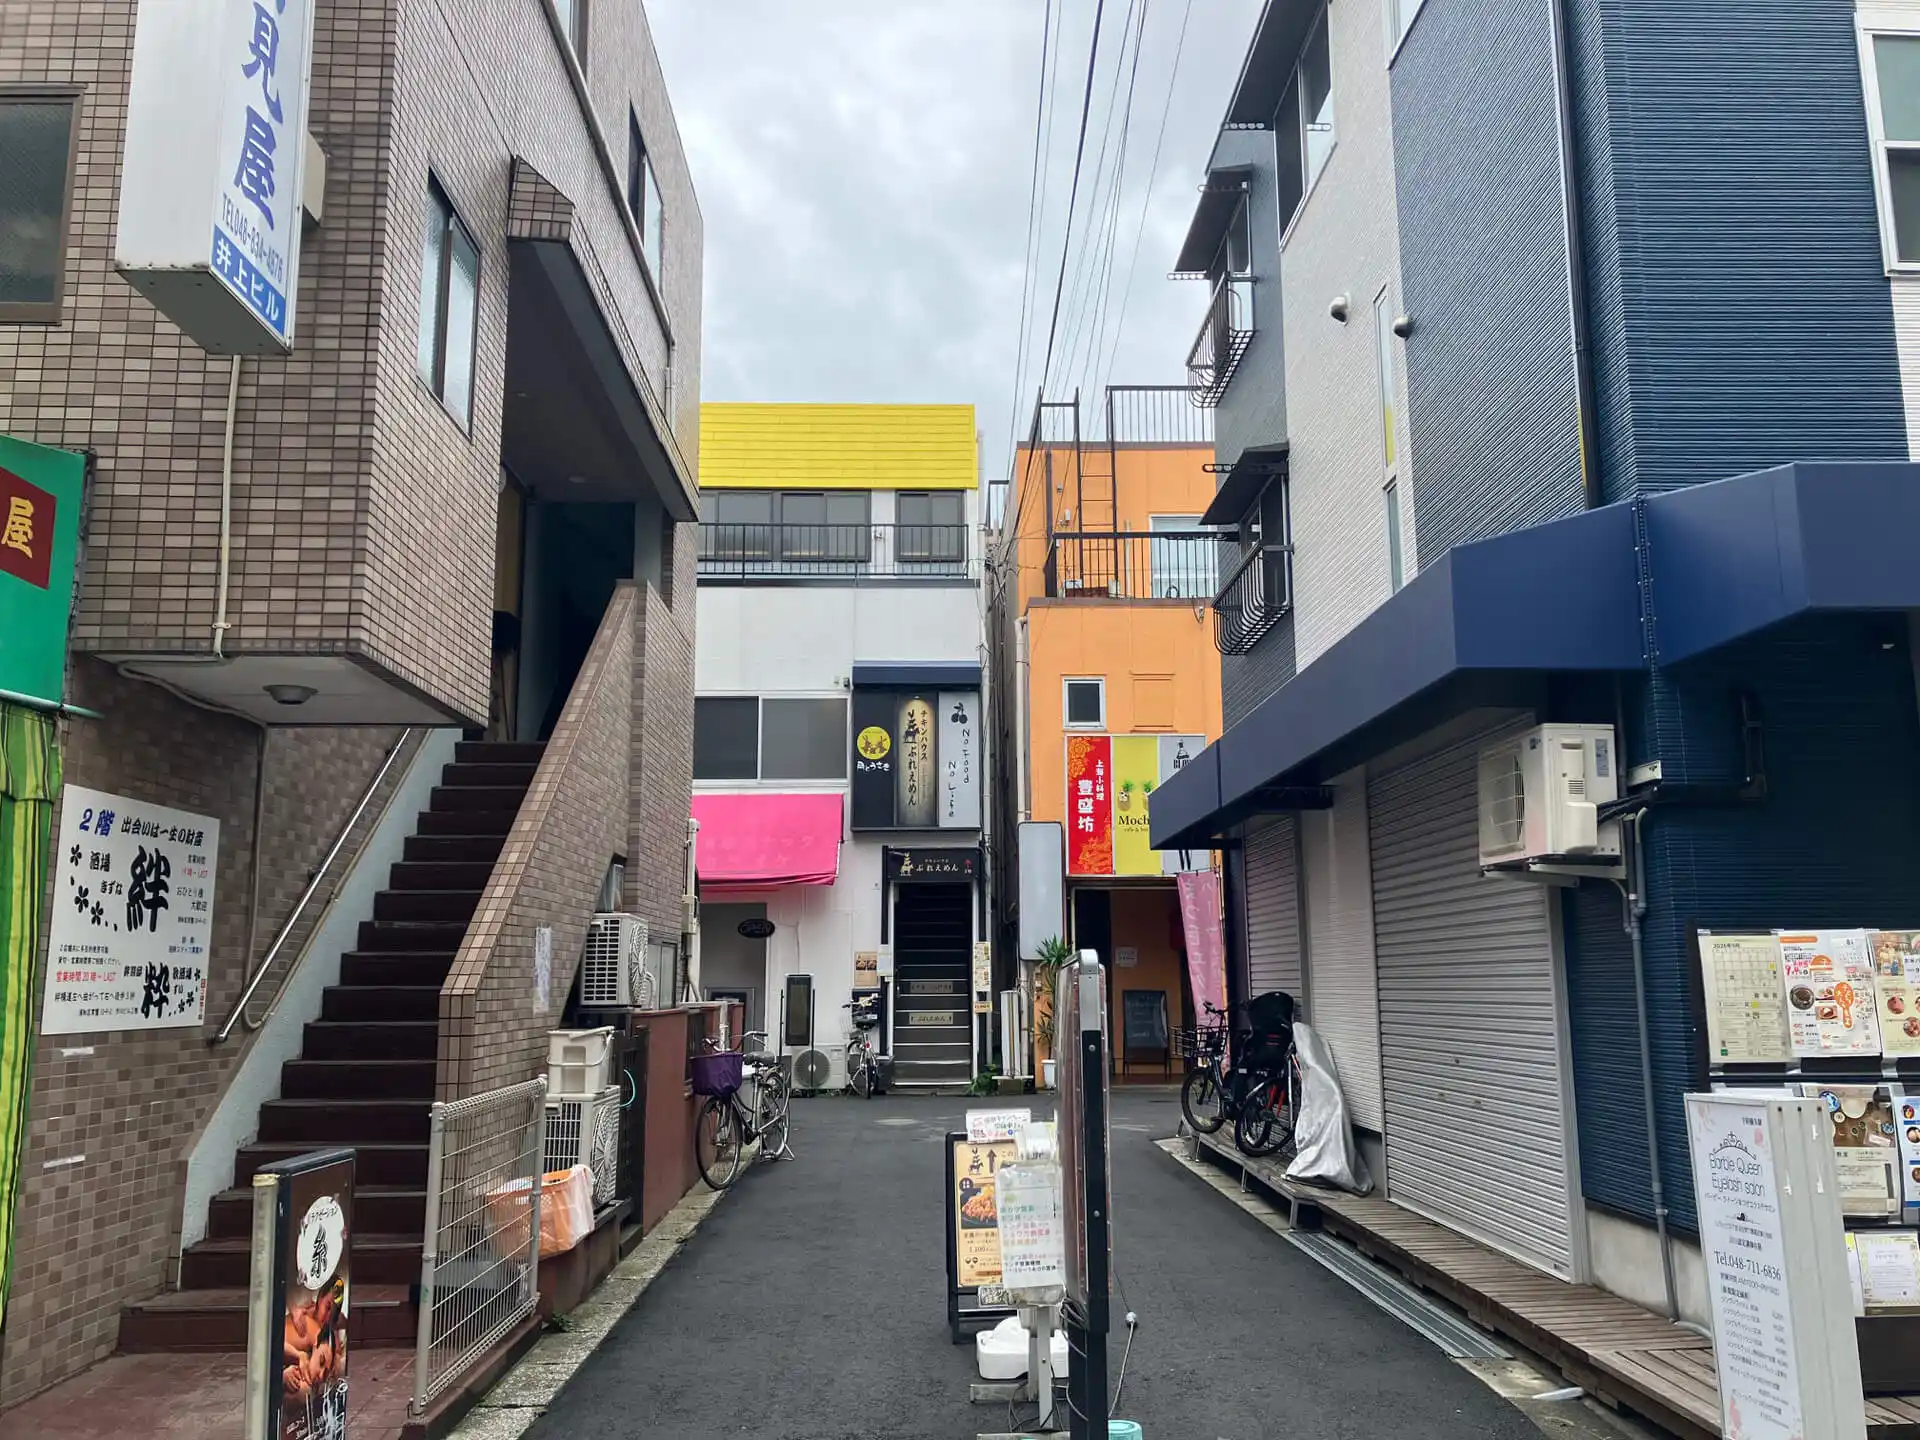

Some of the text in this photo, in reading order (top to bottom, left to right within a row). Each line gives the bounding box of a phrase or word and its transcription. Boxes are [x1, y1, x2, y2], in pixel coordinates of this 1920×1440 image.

[234, 0, 286, 231] 見屋
[216, 237, 279, 321] 井上ビル
[1, 496, 34, 559] 屋
[920, 710, 928, 761] チキンハウス
[908, 746, 917, 806] ぶれえめん
[79, 808, 115, 837] 2階
[89, 850, 111, 872] 酒場
[916, 863, 959, 872] ぶれえめん
[100, 879, 123, 896] きずな
[127, 844, 171, 932] 絆
[1736, 1157, 1763, 1176] Queen
[1714, 1250, 1781, 1281] Tel.048-711-6836
